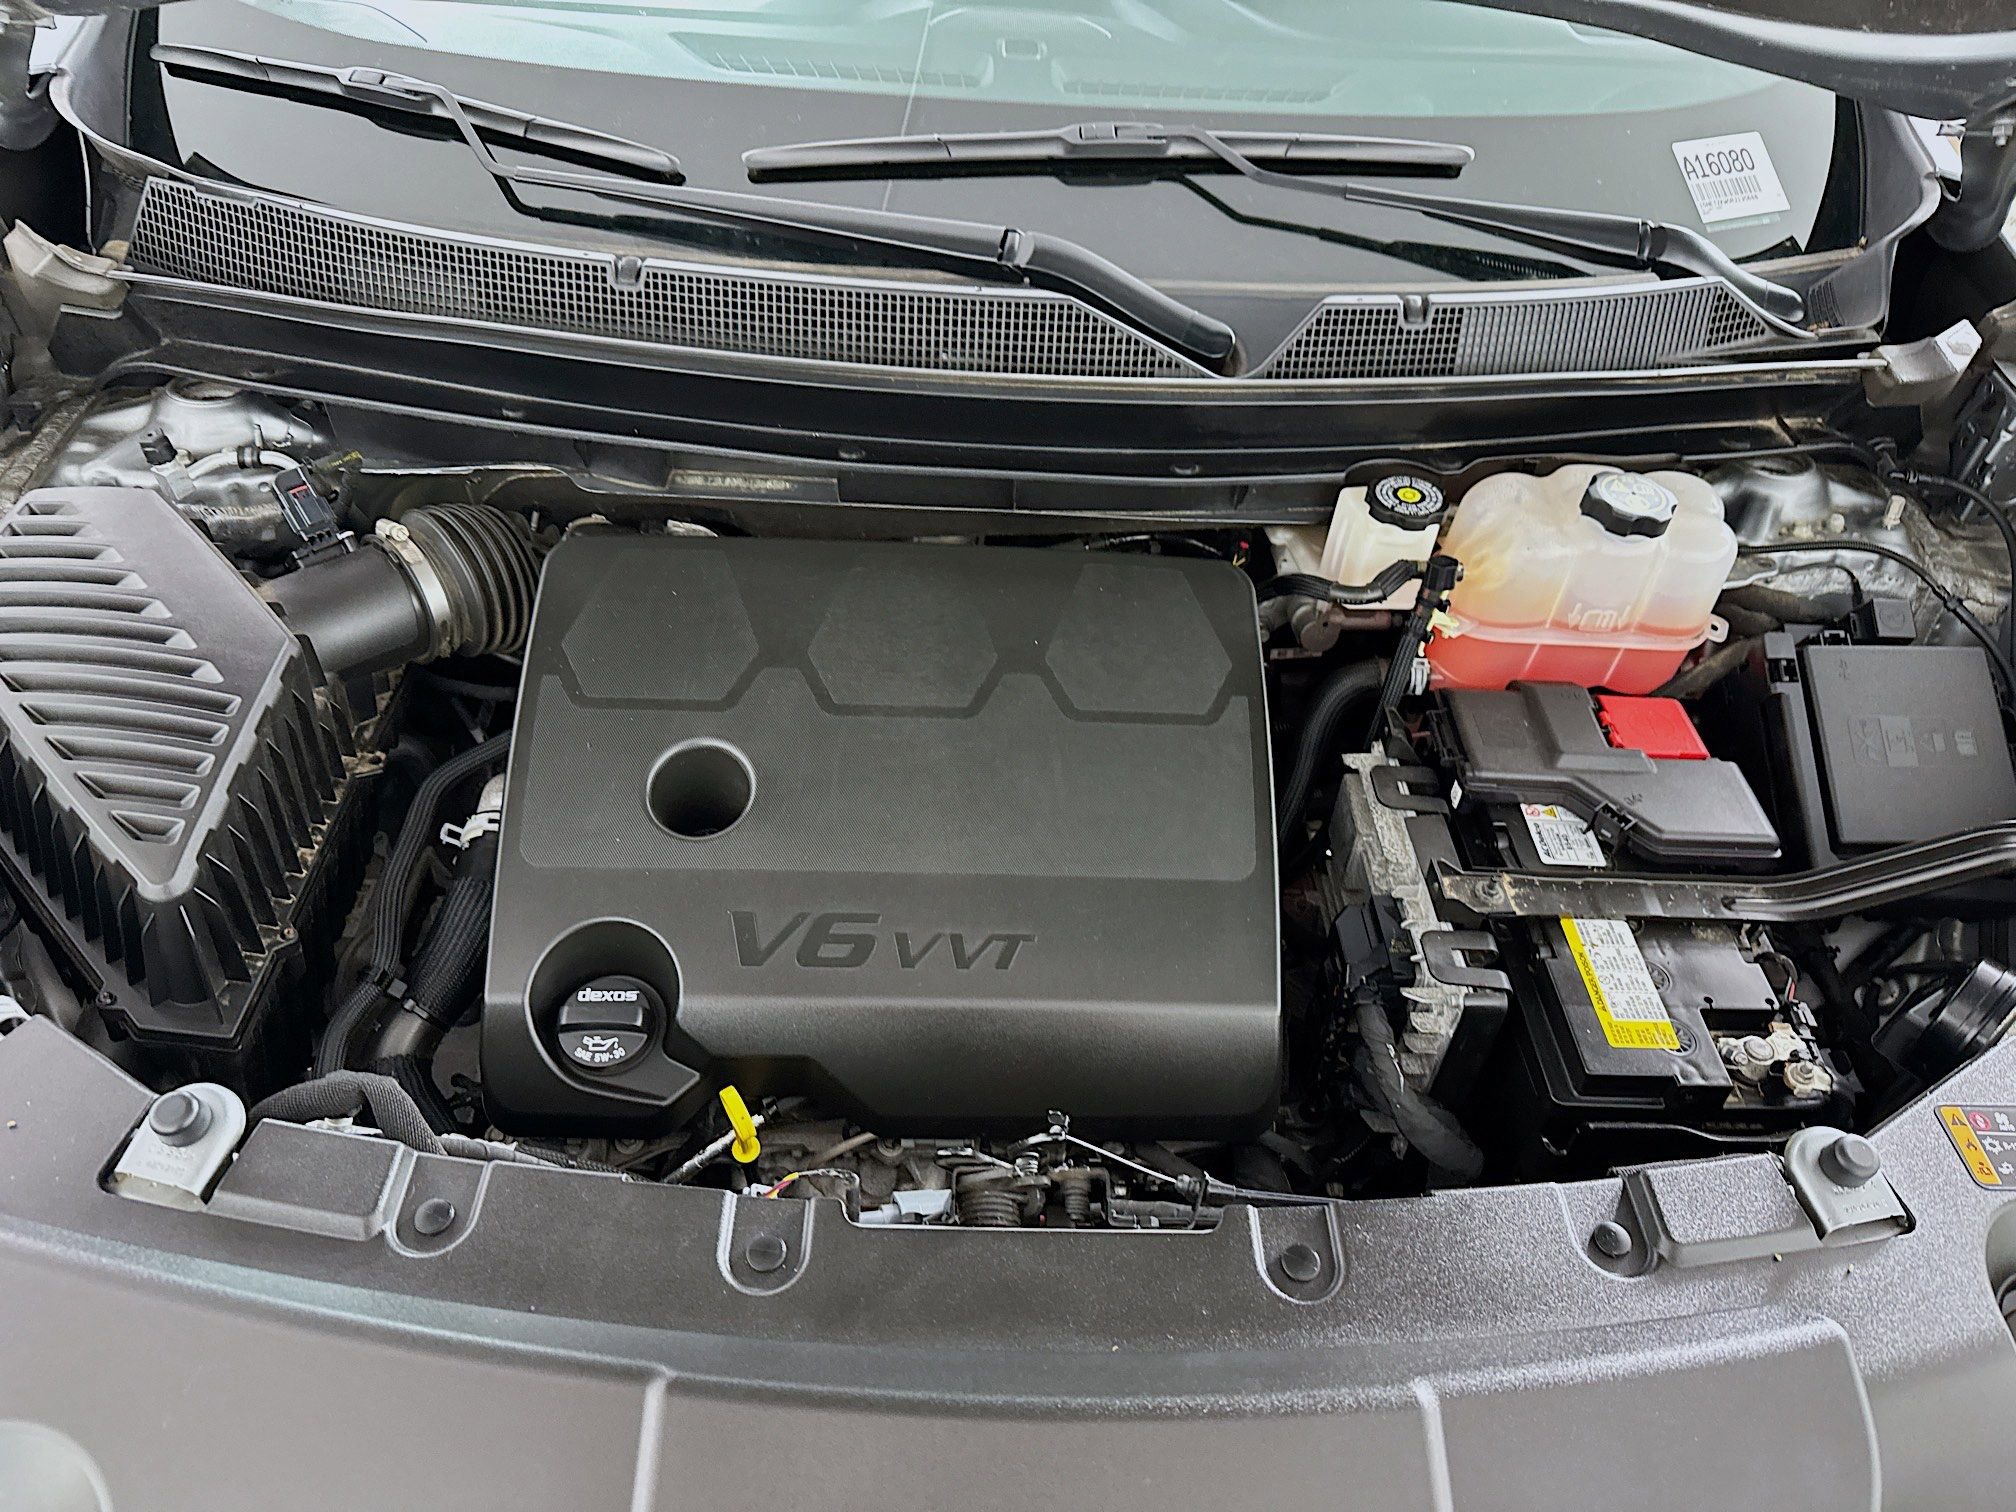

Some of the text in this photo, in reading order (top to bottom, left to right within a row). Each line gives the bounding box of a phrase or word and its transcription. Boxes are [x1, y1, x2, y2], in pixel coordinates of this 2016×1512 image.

[1683, 148, 1755, 180] A16080
[727, 910, 1037, 970] V6 VVT
[577, 987, 640, 1002] dexos
[574, 1047, 593, 1062] SAE
